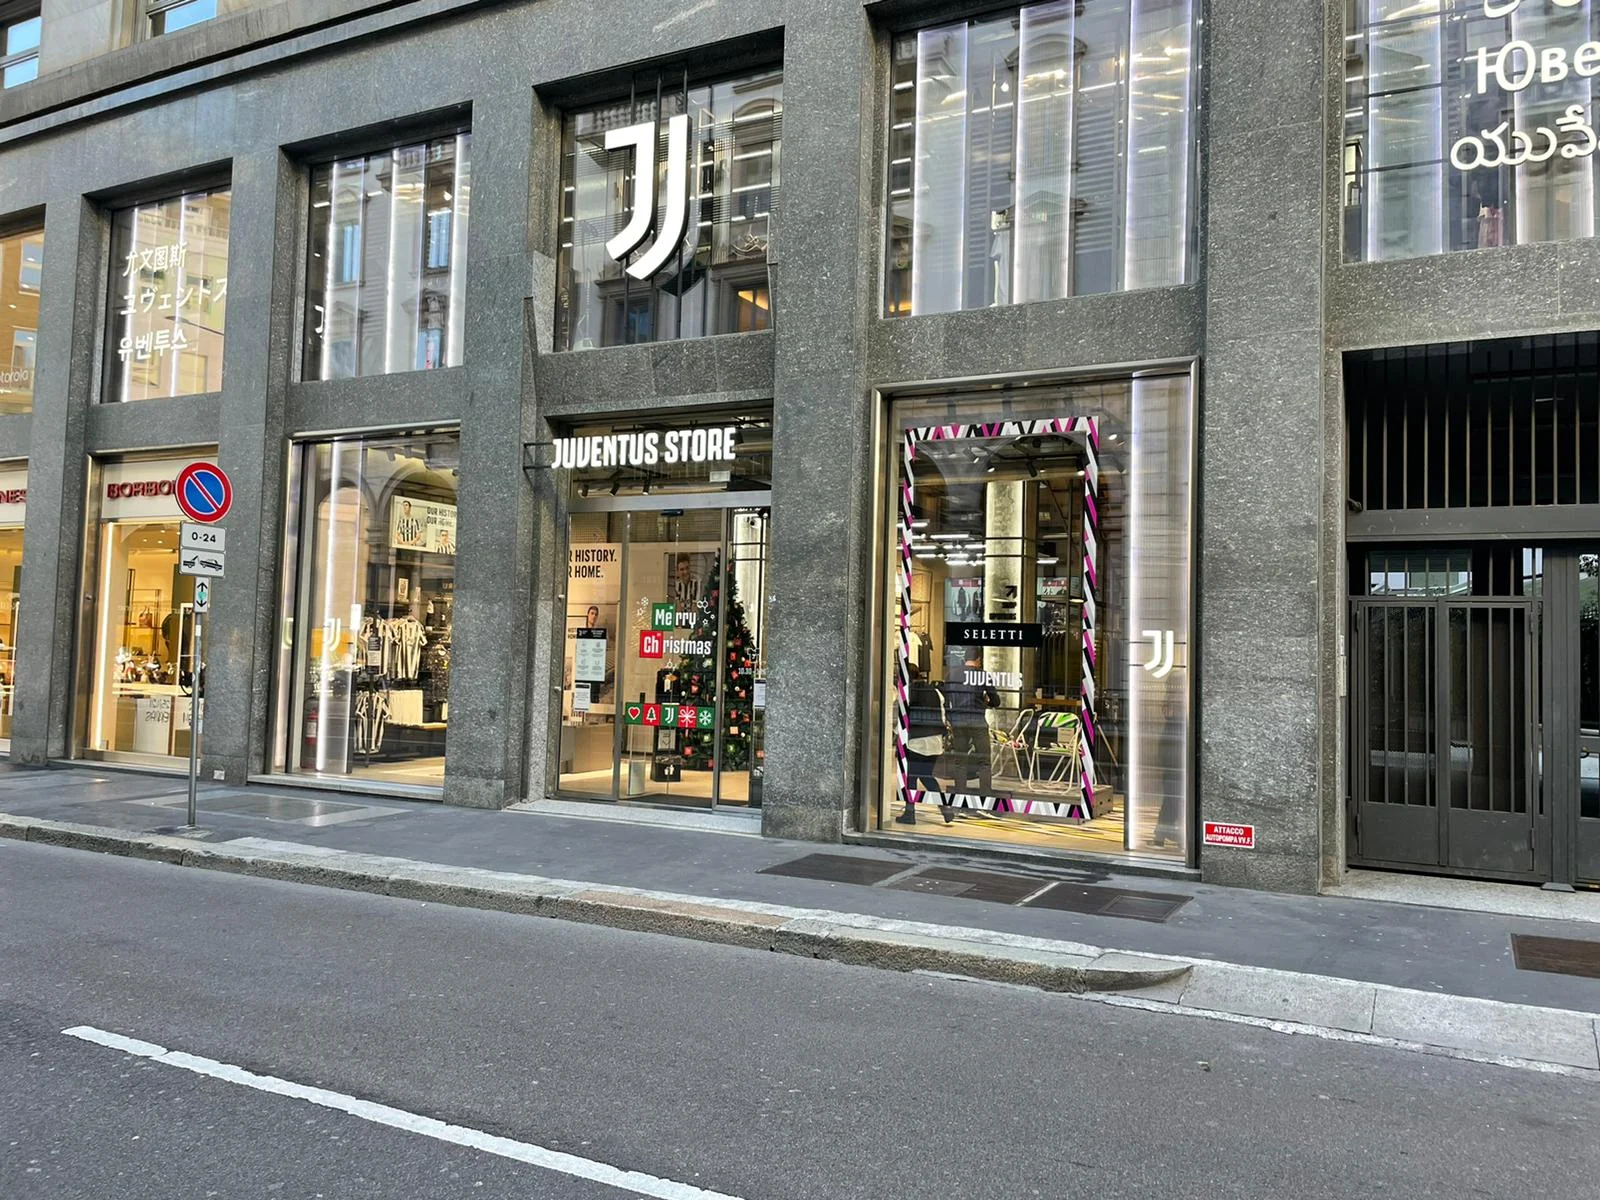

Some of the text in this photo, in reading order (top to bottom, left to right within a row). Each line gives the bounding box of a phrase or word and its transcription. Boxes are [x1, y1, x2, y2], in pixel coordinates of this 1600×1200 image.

[1450, 104, 1600, 170] యువే
[122, 241, 188, 277] 尤文图斯
[118, 329, 188, 361] 유벤투스
[551, 427, 737, 469] JUVENTUS STORE
[107, 480, 176, 498] BORBO
[191, 531, 217, 544] 0-24
[575, 549, 617, 562] HISTORY.
[574, 565, 604, 578] HOME.
[655, 608, 696, 629] Merry
[963, 628, 1023, 640] SELETTI
[643, 635, 711, 655] Christmas
[963, 670, 1023, 688] JUVENTUS
[1213, 826, 1244, 835] ATTACCO
